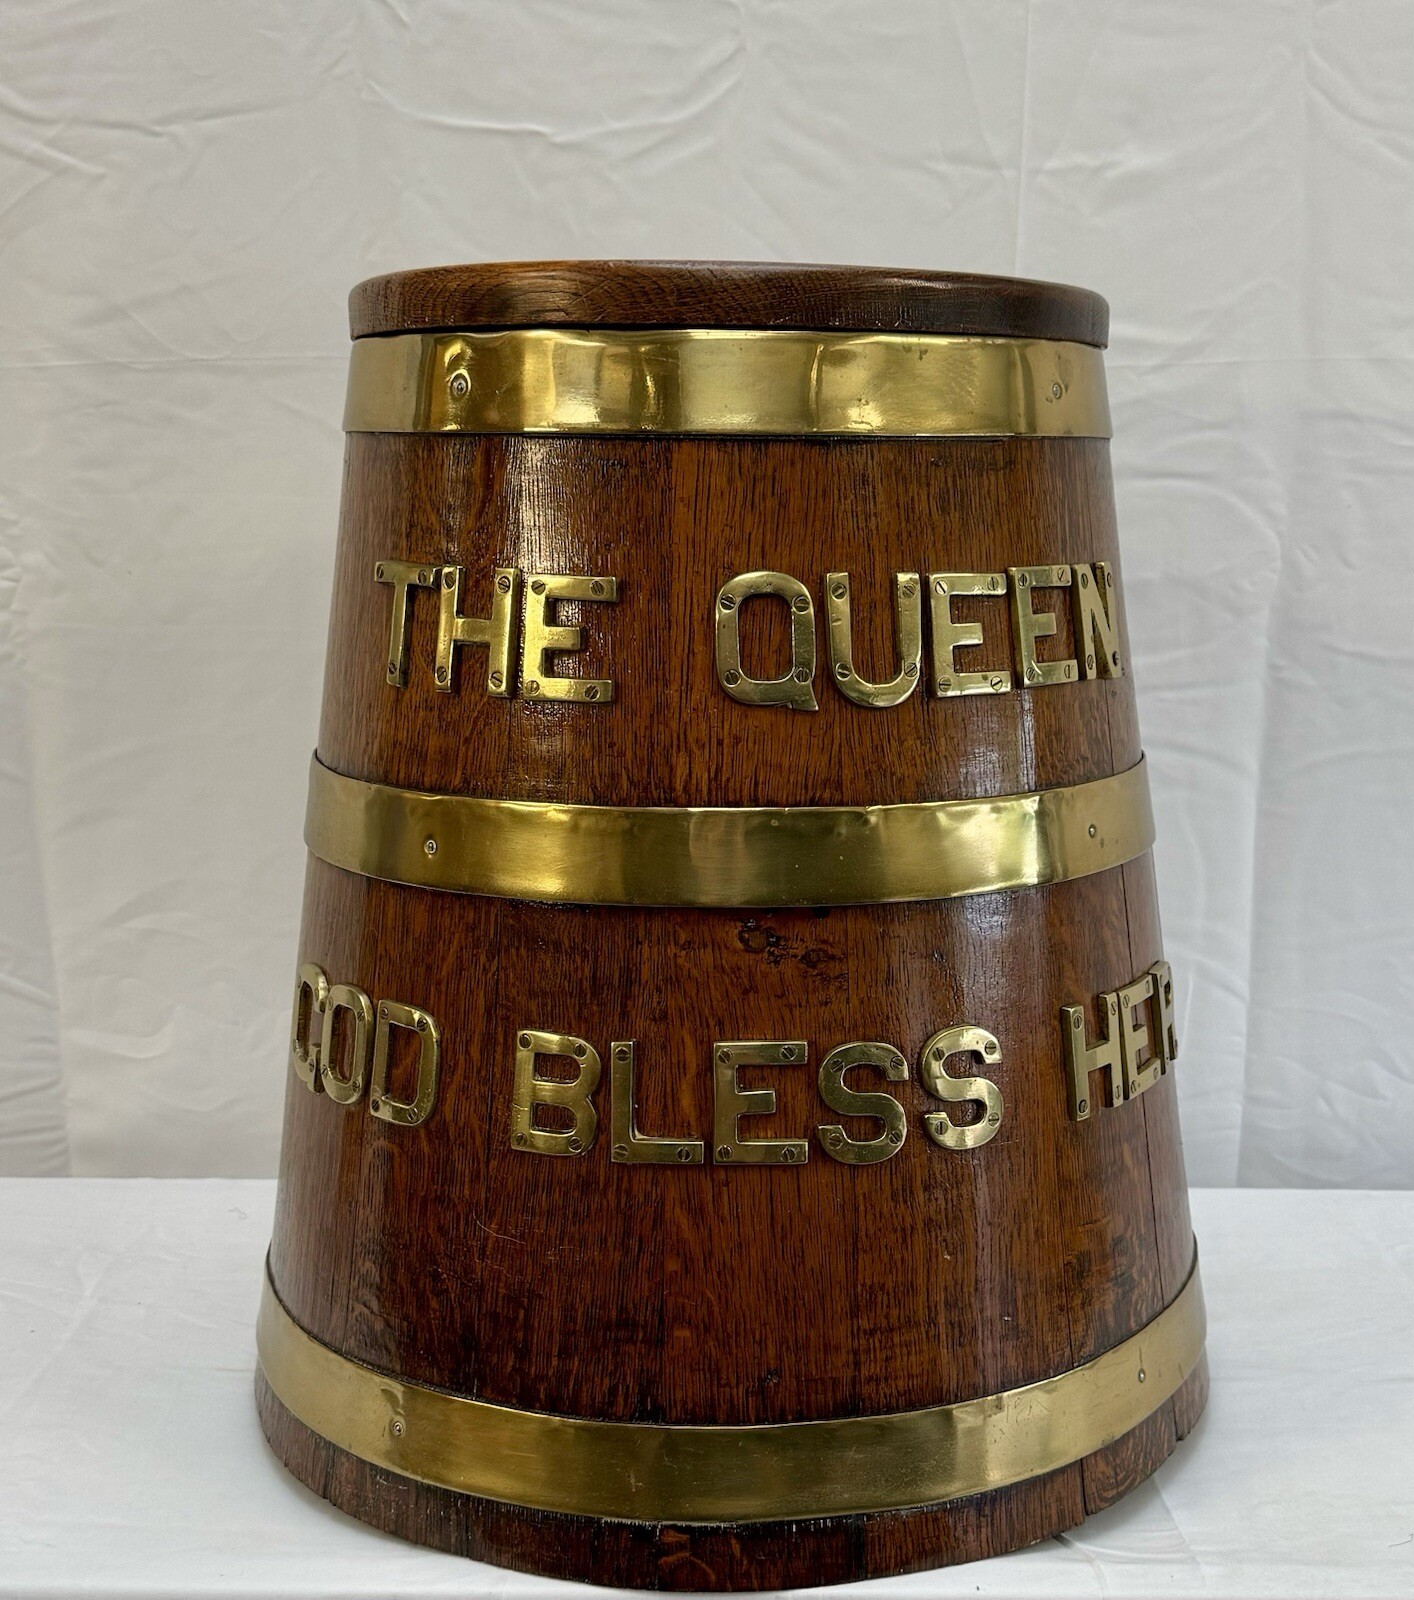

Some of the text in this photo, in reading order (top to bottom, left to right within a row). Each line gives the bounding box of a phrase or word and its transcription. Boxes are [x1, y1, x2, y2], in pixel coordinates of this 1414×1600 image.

[374, 560, 1122, 711] THE QUEEN
[292, 960, 1178, 1165] GOD BLESS HER
